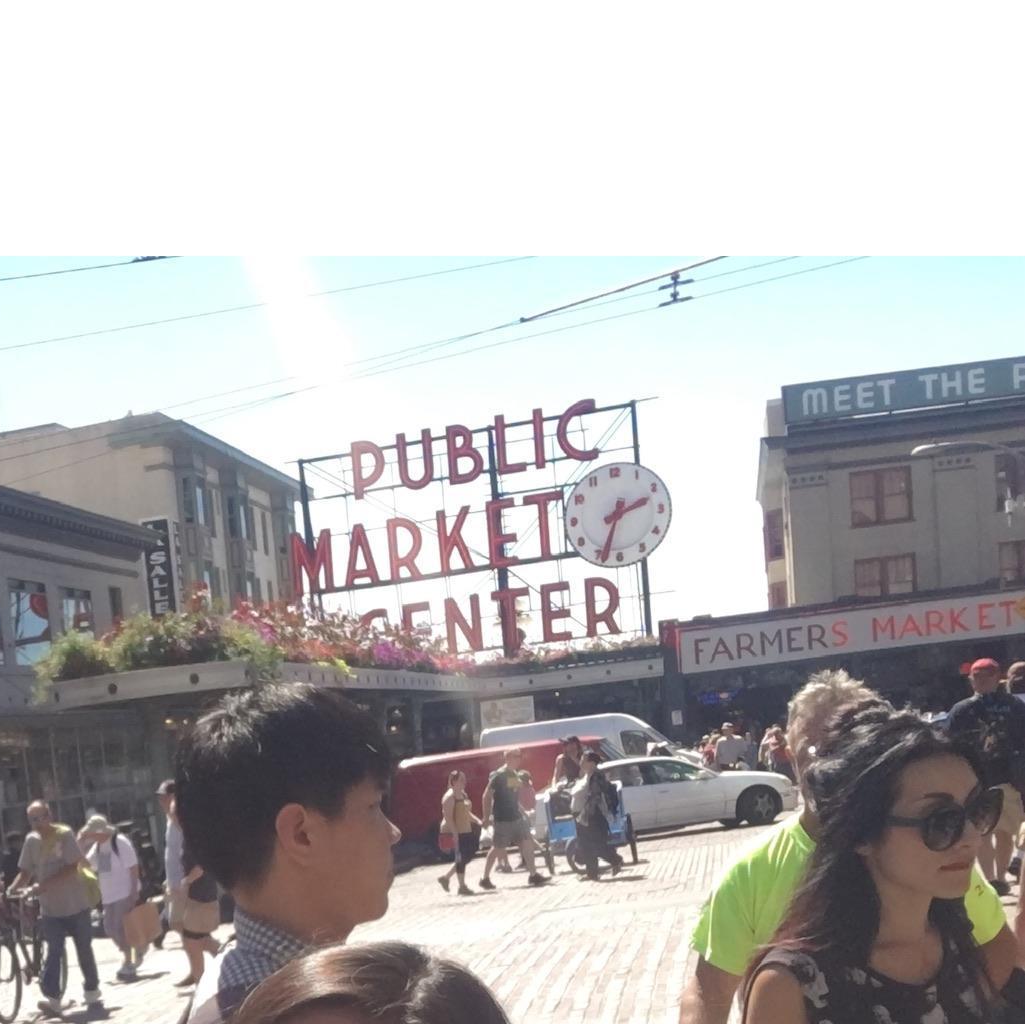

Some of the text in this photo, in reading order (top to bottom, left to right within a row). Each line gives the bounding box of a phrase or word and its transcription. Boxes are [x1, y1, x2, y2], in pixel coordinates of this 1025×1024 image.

[801, 378, 896, 416] MEET
[919, 368, 985, 400] THE
[350, 398, 600, 500] PUBLIC
[609, 467, 621, 478] 12
[589, 476, 598, 487] 11
[650, 483, 658, 493] 2
[575, 494, 585, 506] 10
[658, 504, 665, 514] 3
[570, 517, 578, 527] 9
[651, 526, 661, 535] 4
[289, 489, 565, 597] MARKET
[578, 537, 585, 547] 8
[639, 543, 646, 553] 5
[616, 552, 624, 562] 6
[149, 551, 170, 614] SALLE
[693, 600, 1018, 666] FARMERS MARKET
